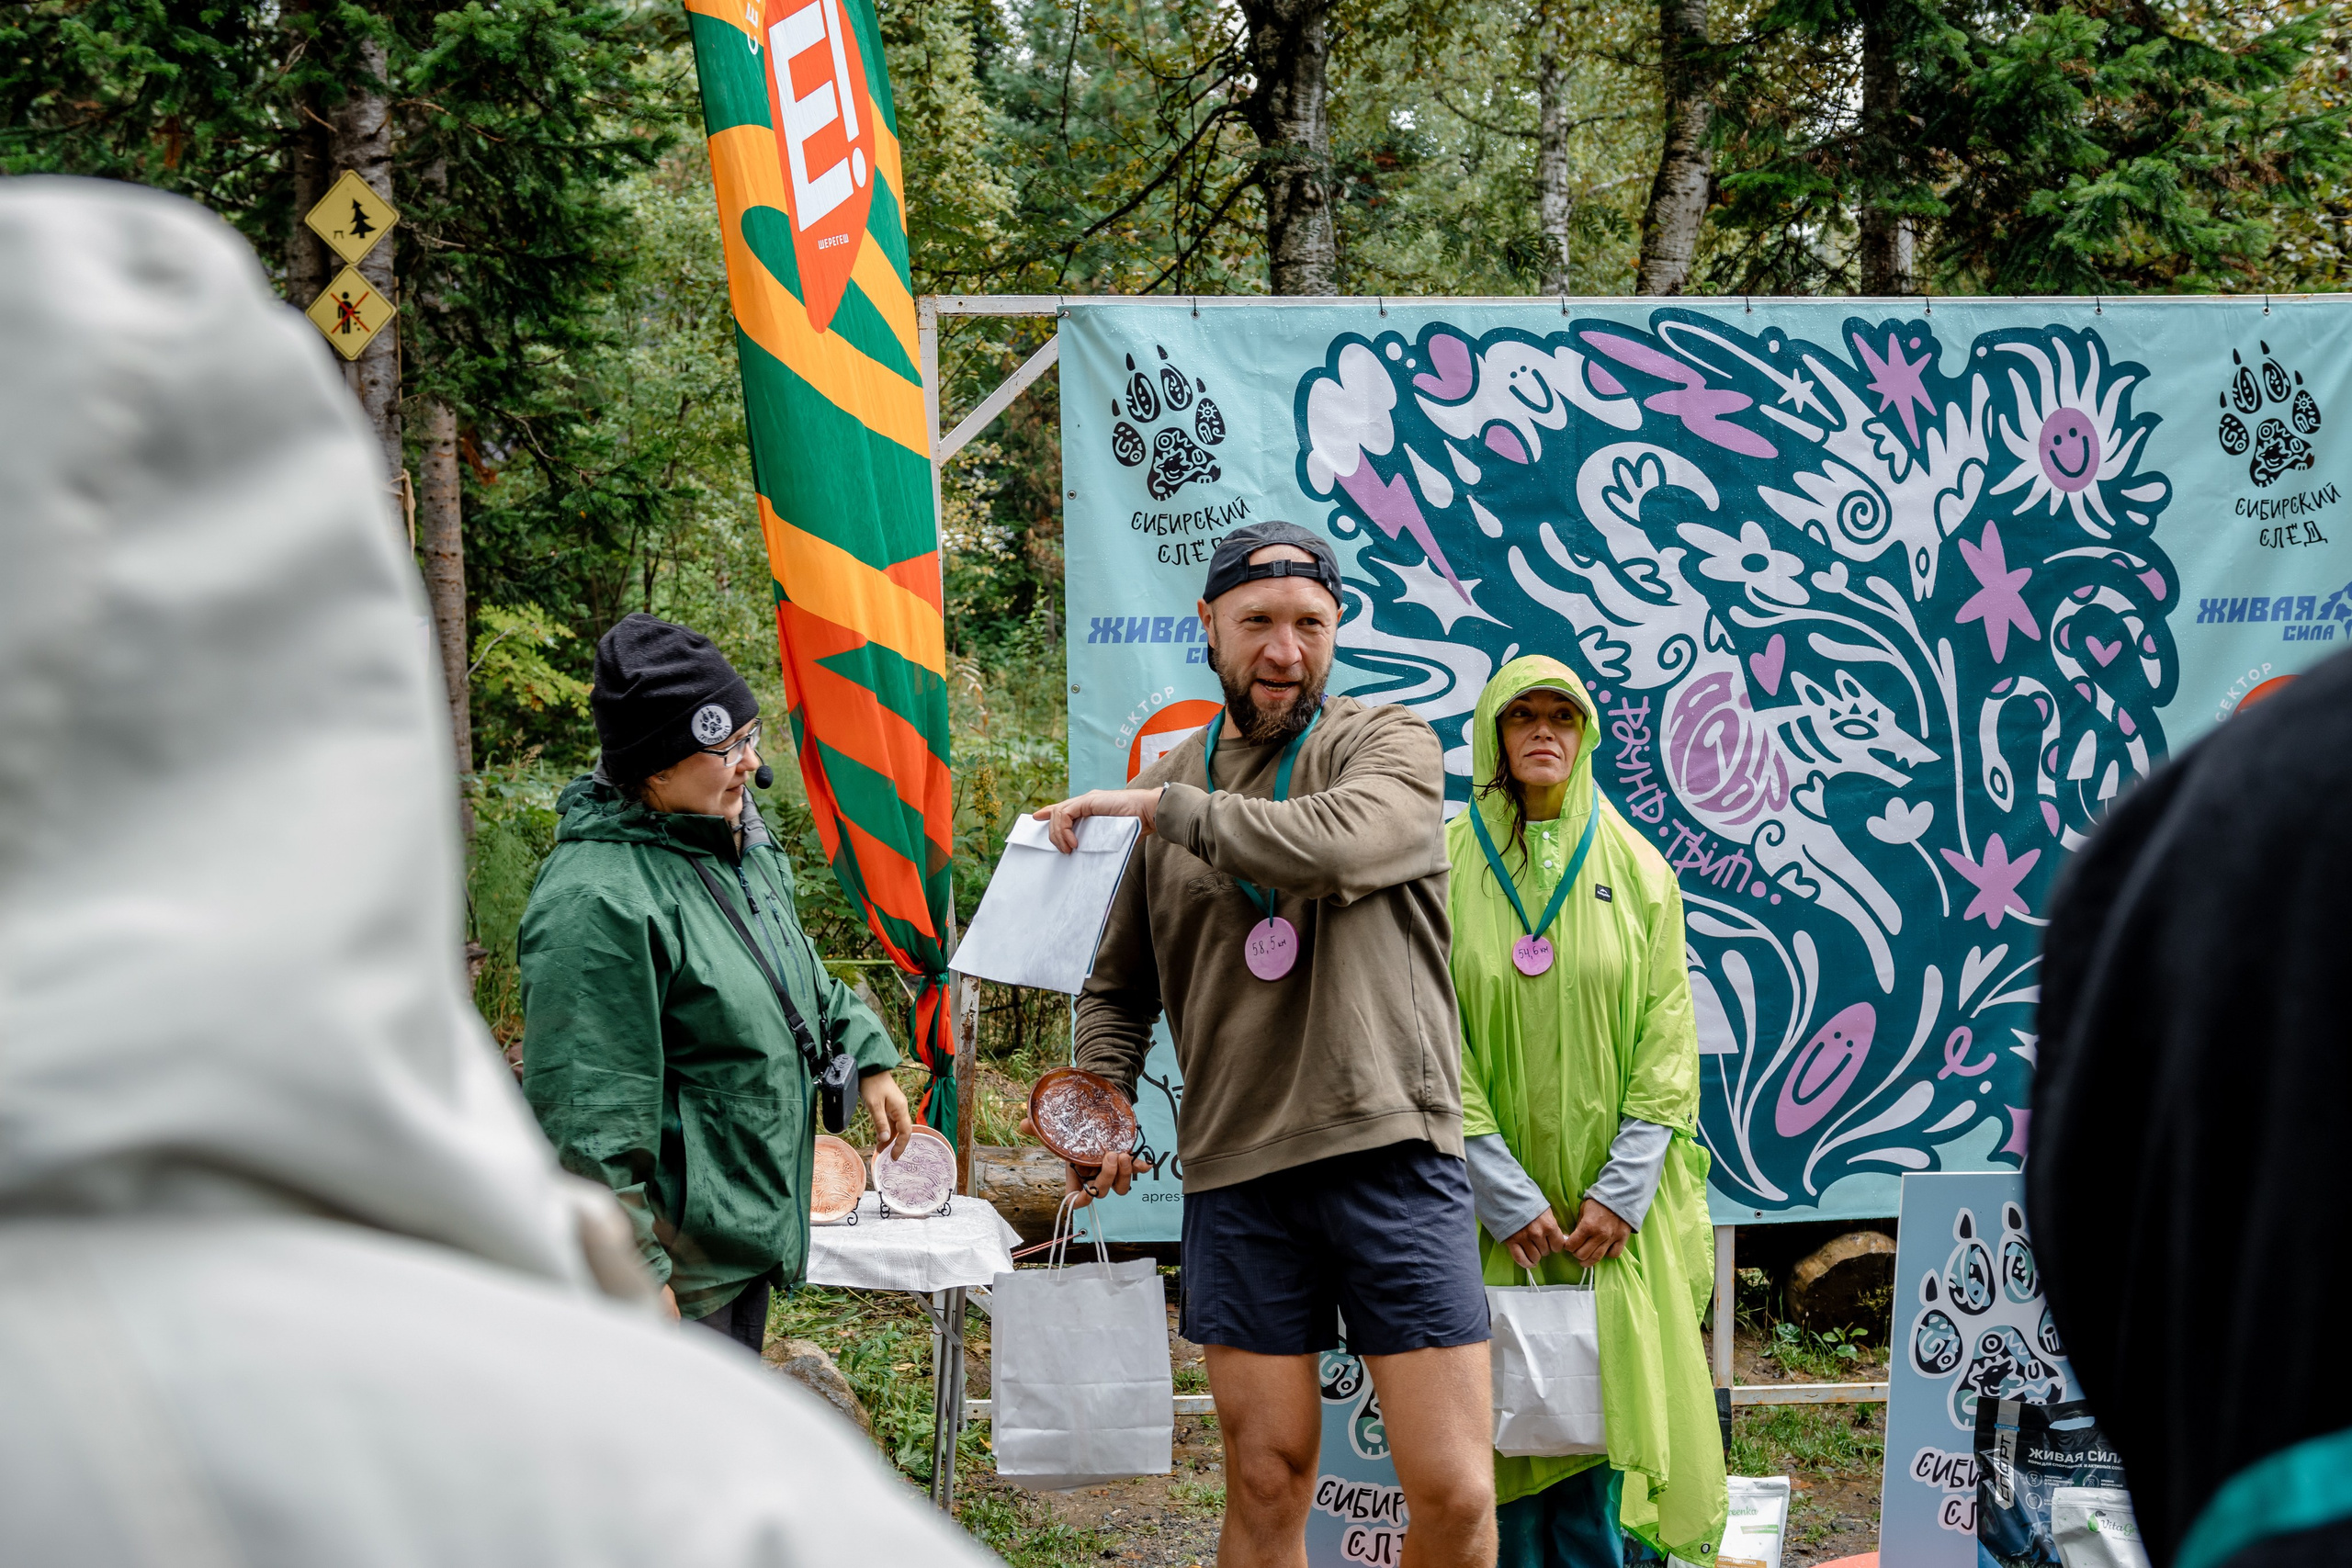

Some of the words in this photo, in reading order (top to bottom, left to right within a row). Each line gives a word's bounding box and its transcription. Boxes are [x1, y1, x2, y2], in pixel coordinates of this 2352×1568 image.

[745, 0, 760, 55] СЕ
[818, 233, 849, 250] ШЕРЕГЕШ
[1131, 496, 1251, 536] СИБИРСКИЙ
[2235, 482, 2341, 520] СИБИРСКИЙ
[2196, 595, 2317, 624] ЖИВАЯ
[2282, 625, 2335, 641] СИЛА
[2215, 662, 2272, 722] СЕКТОР
[1114, 685, 1175, 750] СЕКТОР
[1252, 936, 1275, 955] 58,5
[2028, 1448, 2084, 1463] ЖИВАЯ
[1348, 1530, 1407, 1564] СЛ
